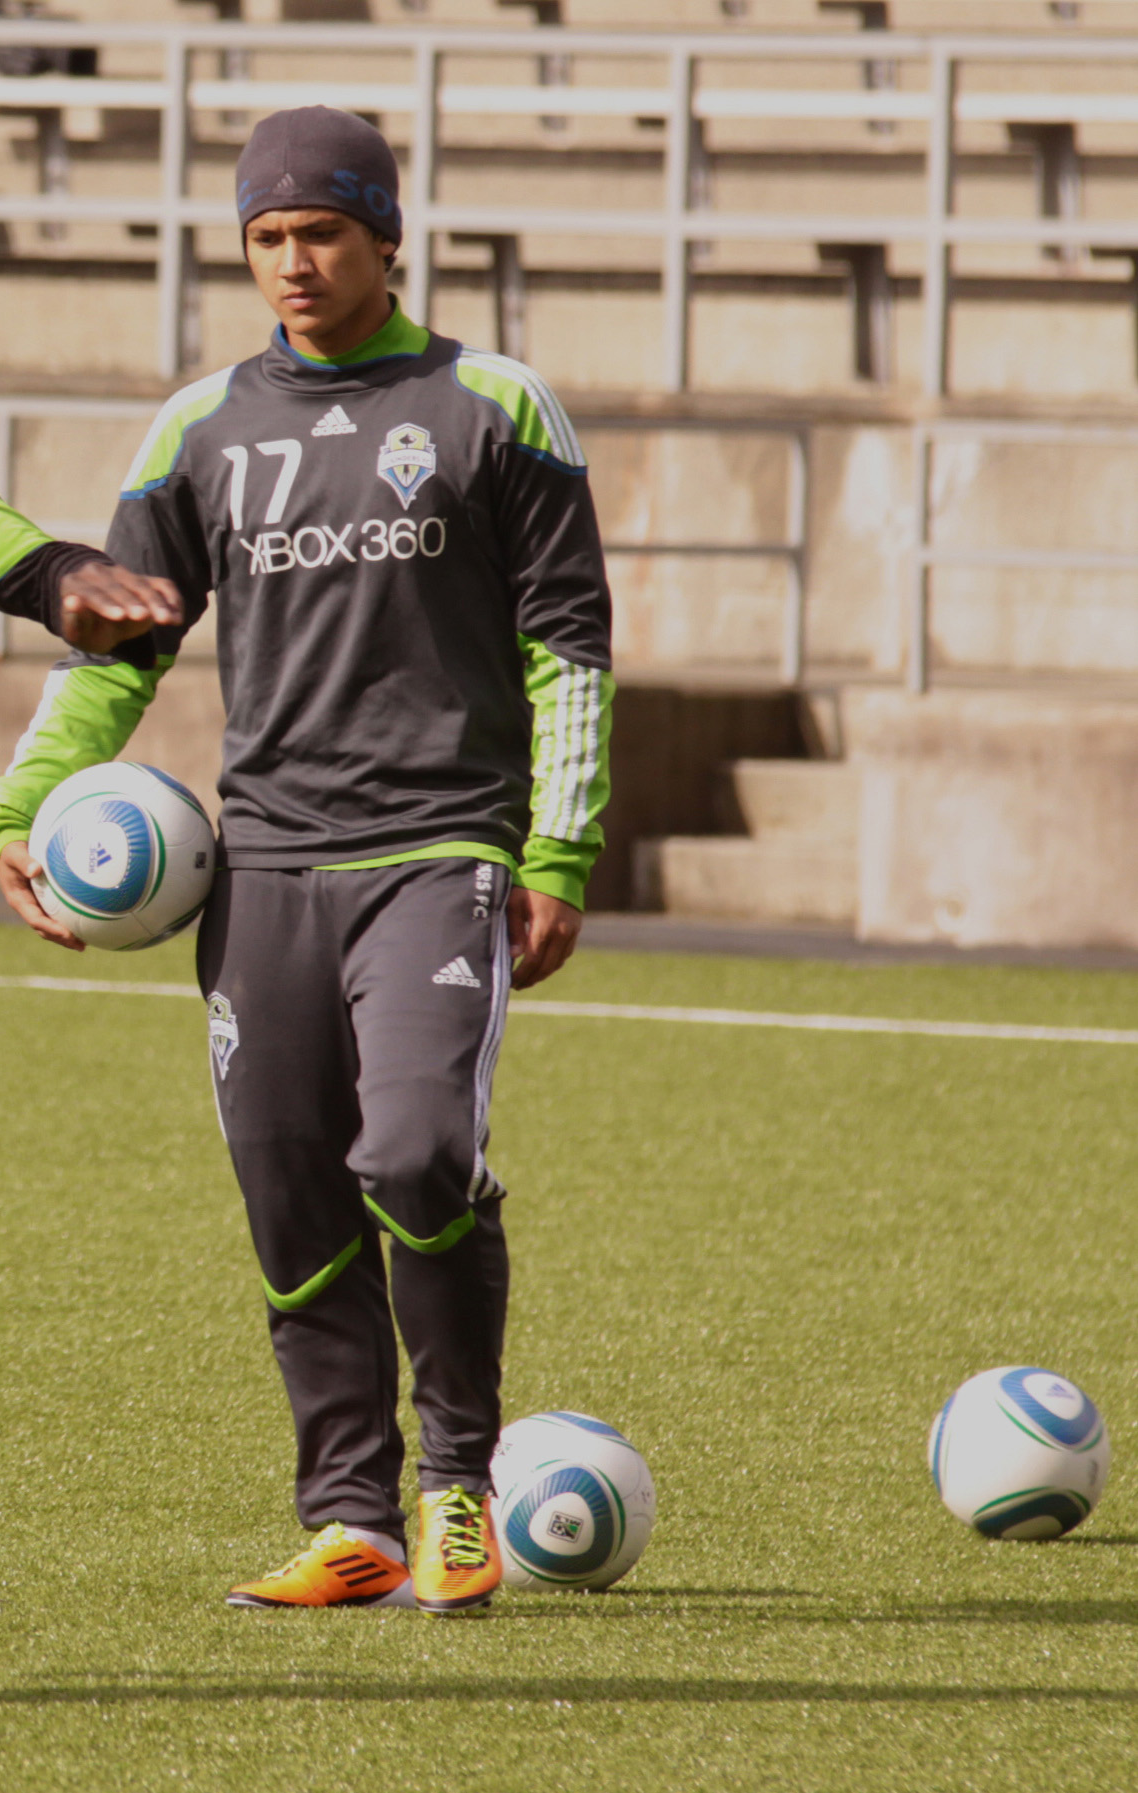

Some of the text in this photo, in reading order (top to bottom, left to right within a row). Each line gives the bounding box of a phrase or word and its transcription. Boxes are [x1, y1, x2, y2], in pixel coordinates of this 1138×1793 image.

[329, 169, 400, 226] SO
[222, 439, 302, 531] 17
[240, 517, 446, 575] XBOX 360
